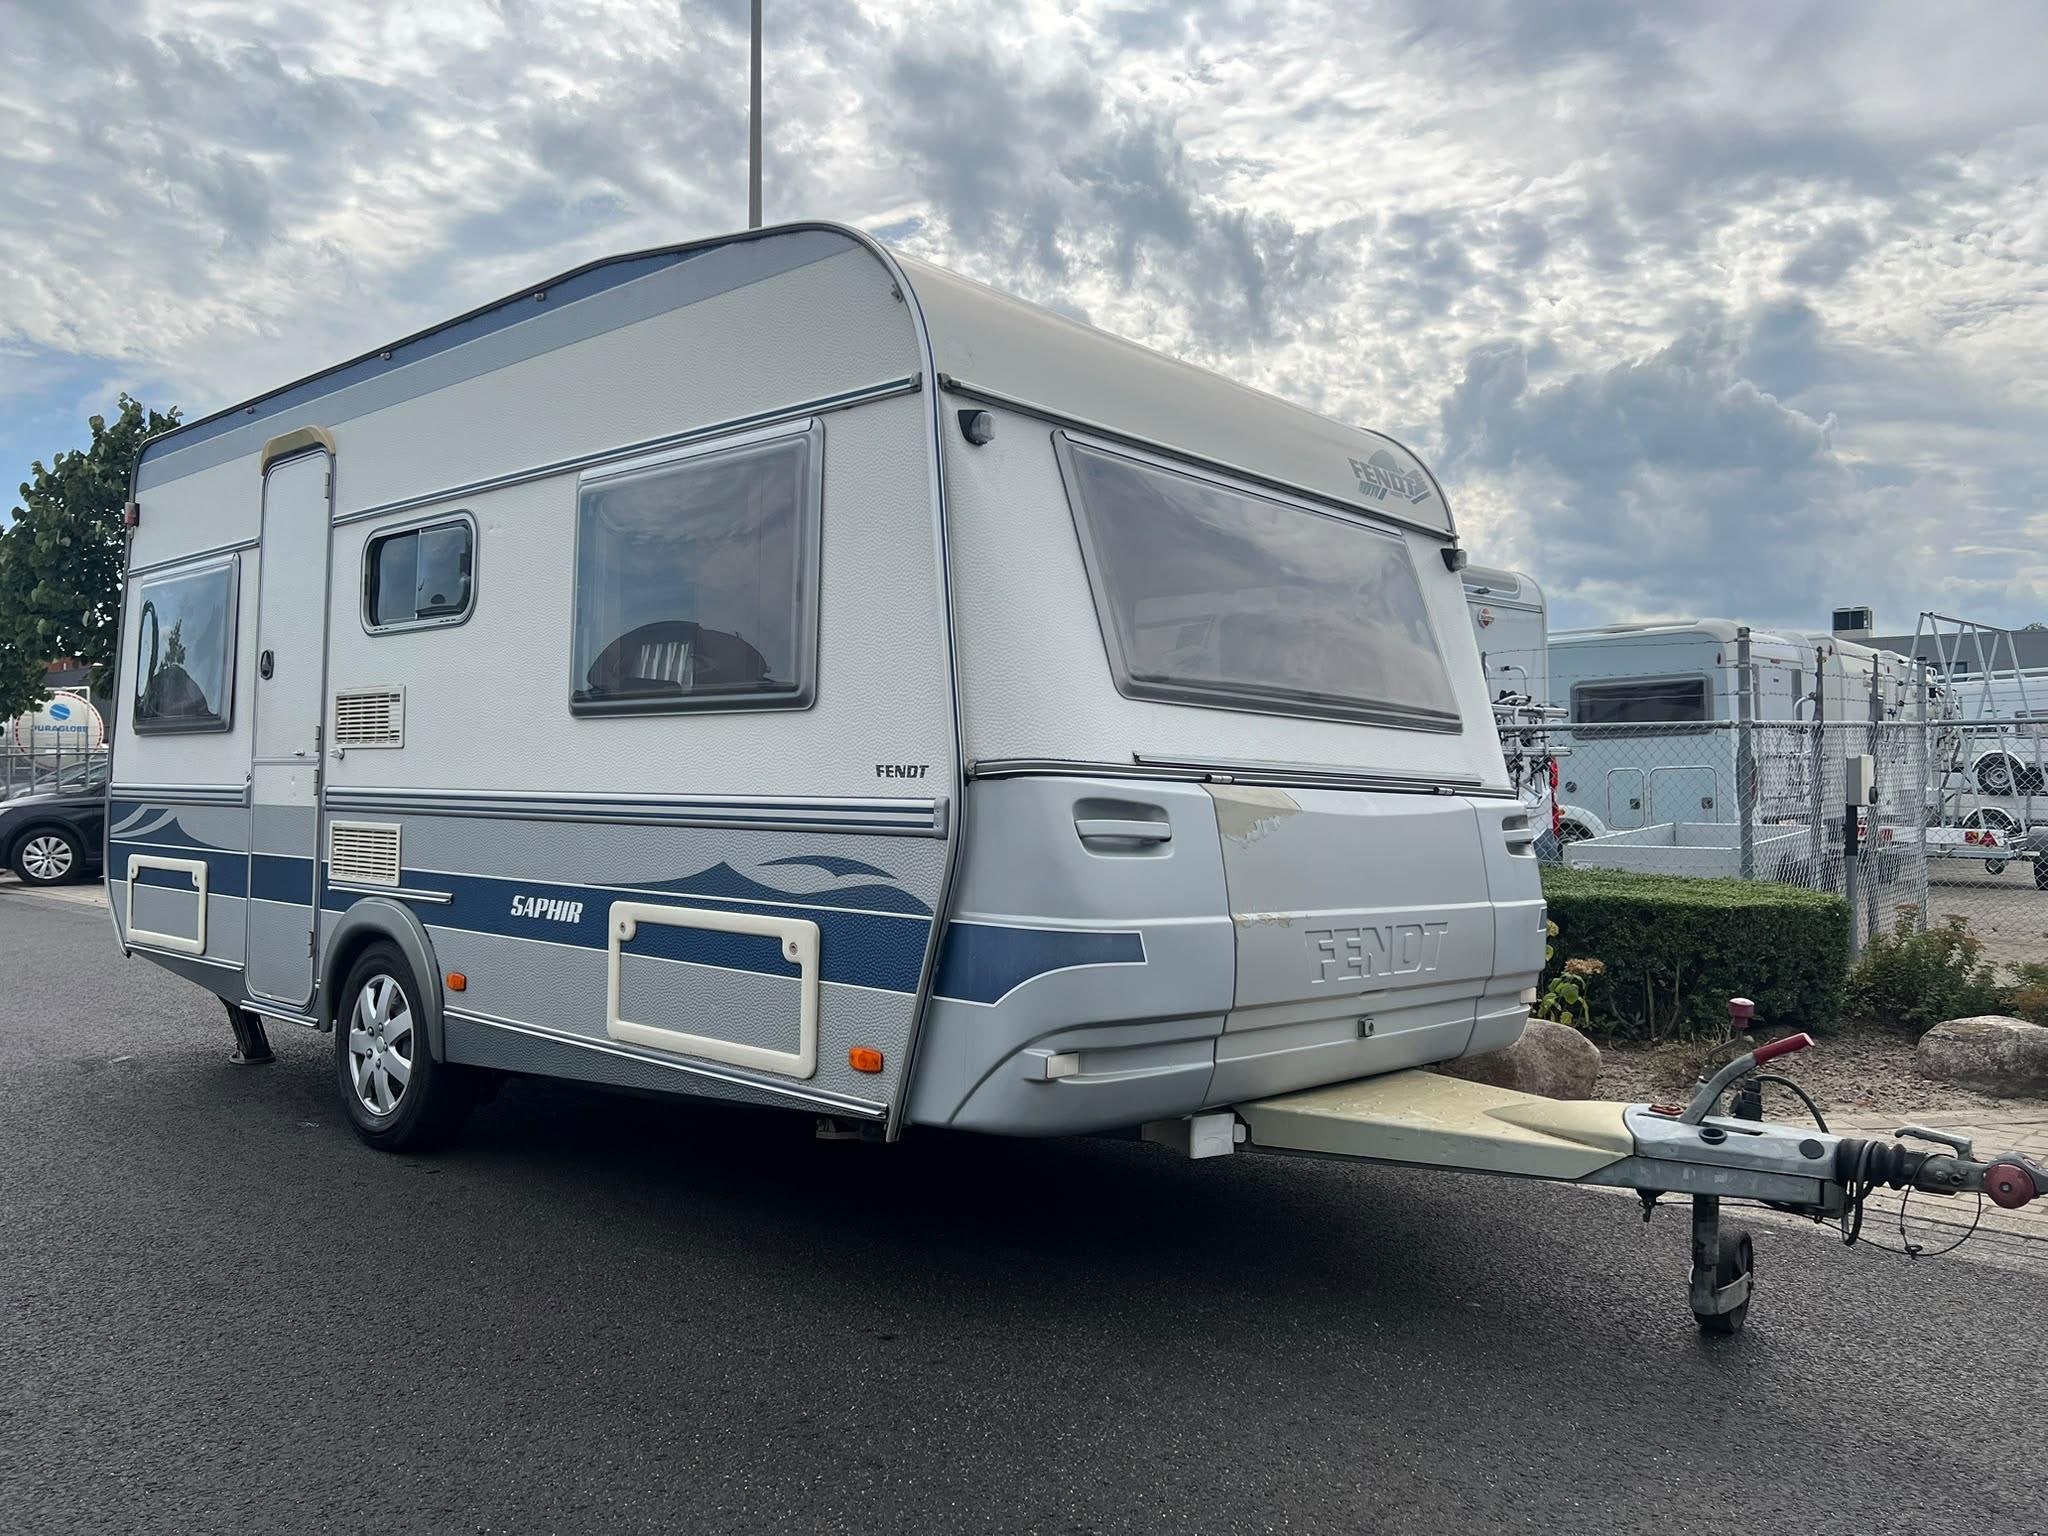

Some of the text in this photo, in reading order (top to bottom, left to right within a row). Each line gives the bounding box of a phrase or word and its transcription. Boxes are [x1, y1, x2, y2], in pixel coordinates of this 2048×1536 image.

[1347, 457, 1417, 499] FENDT
[876, 764, 929, 779] FENDT
[510, 895, 583, 923] SAPHIR
[1304, 921, 1449, 984] FENDT
